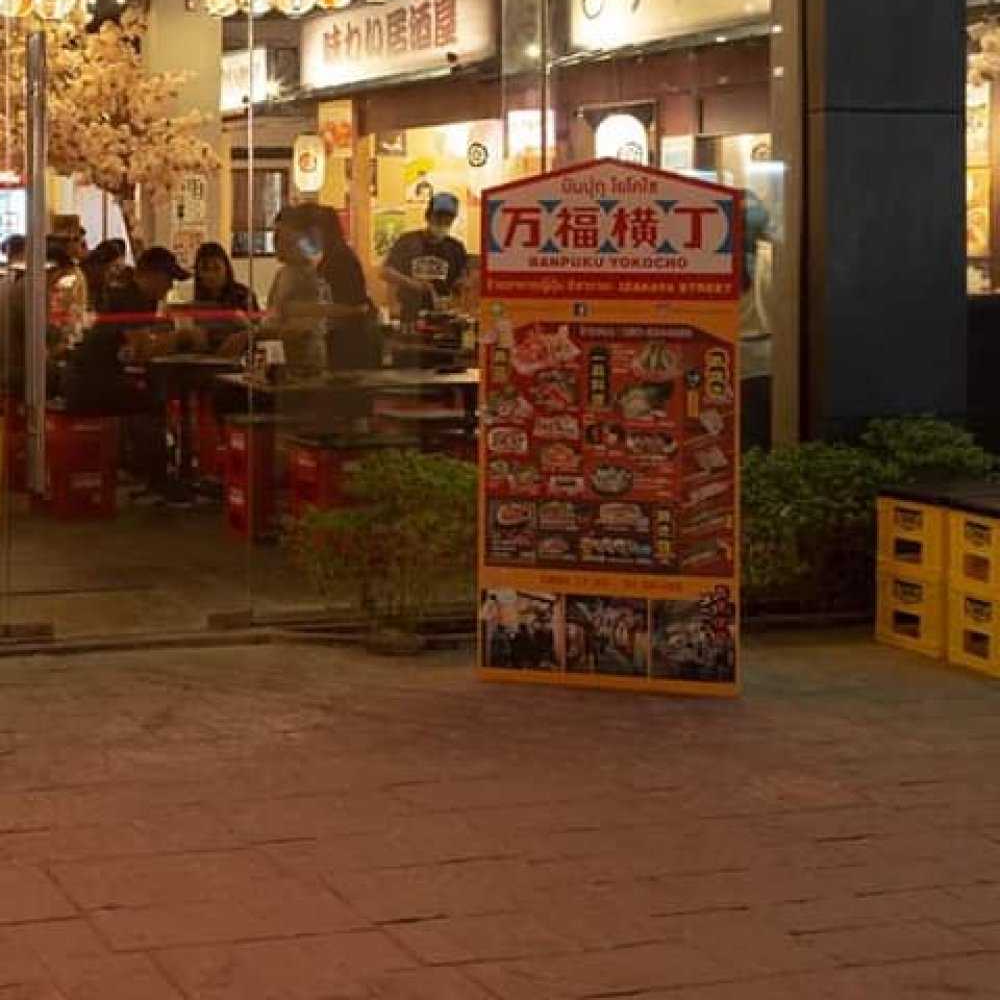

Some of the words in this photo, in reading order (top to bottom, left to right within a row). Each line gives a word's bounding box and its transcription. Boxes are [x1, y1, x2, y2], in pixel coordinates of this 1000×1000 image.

[500, 206, 719, 251] 万福横丁
[528, 256, 603, 269] BANPUKU
[611, 256, 689, 270] YOKOCHO
